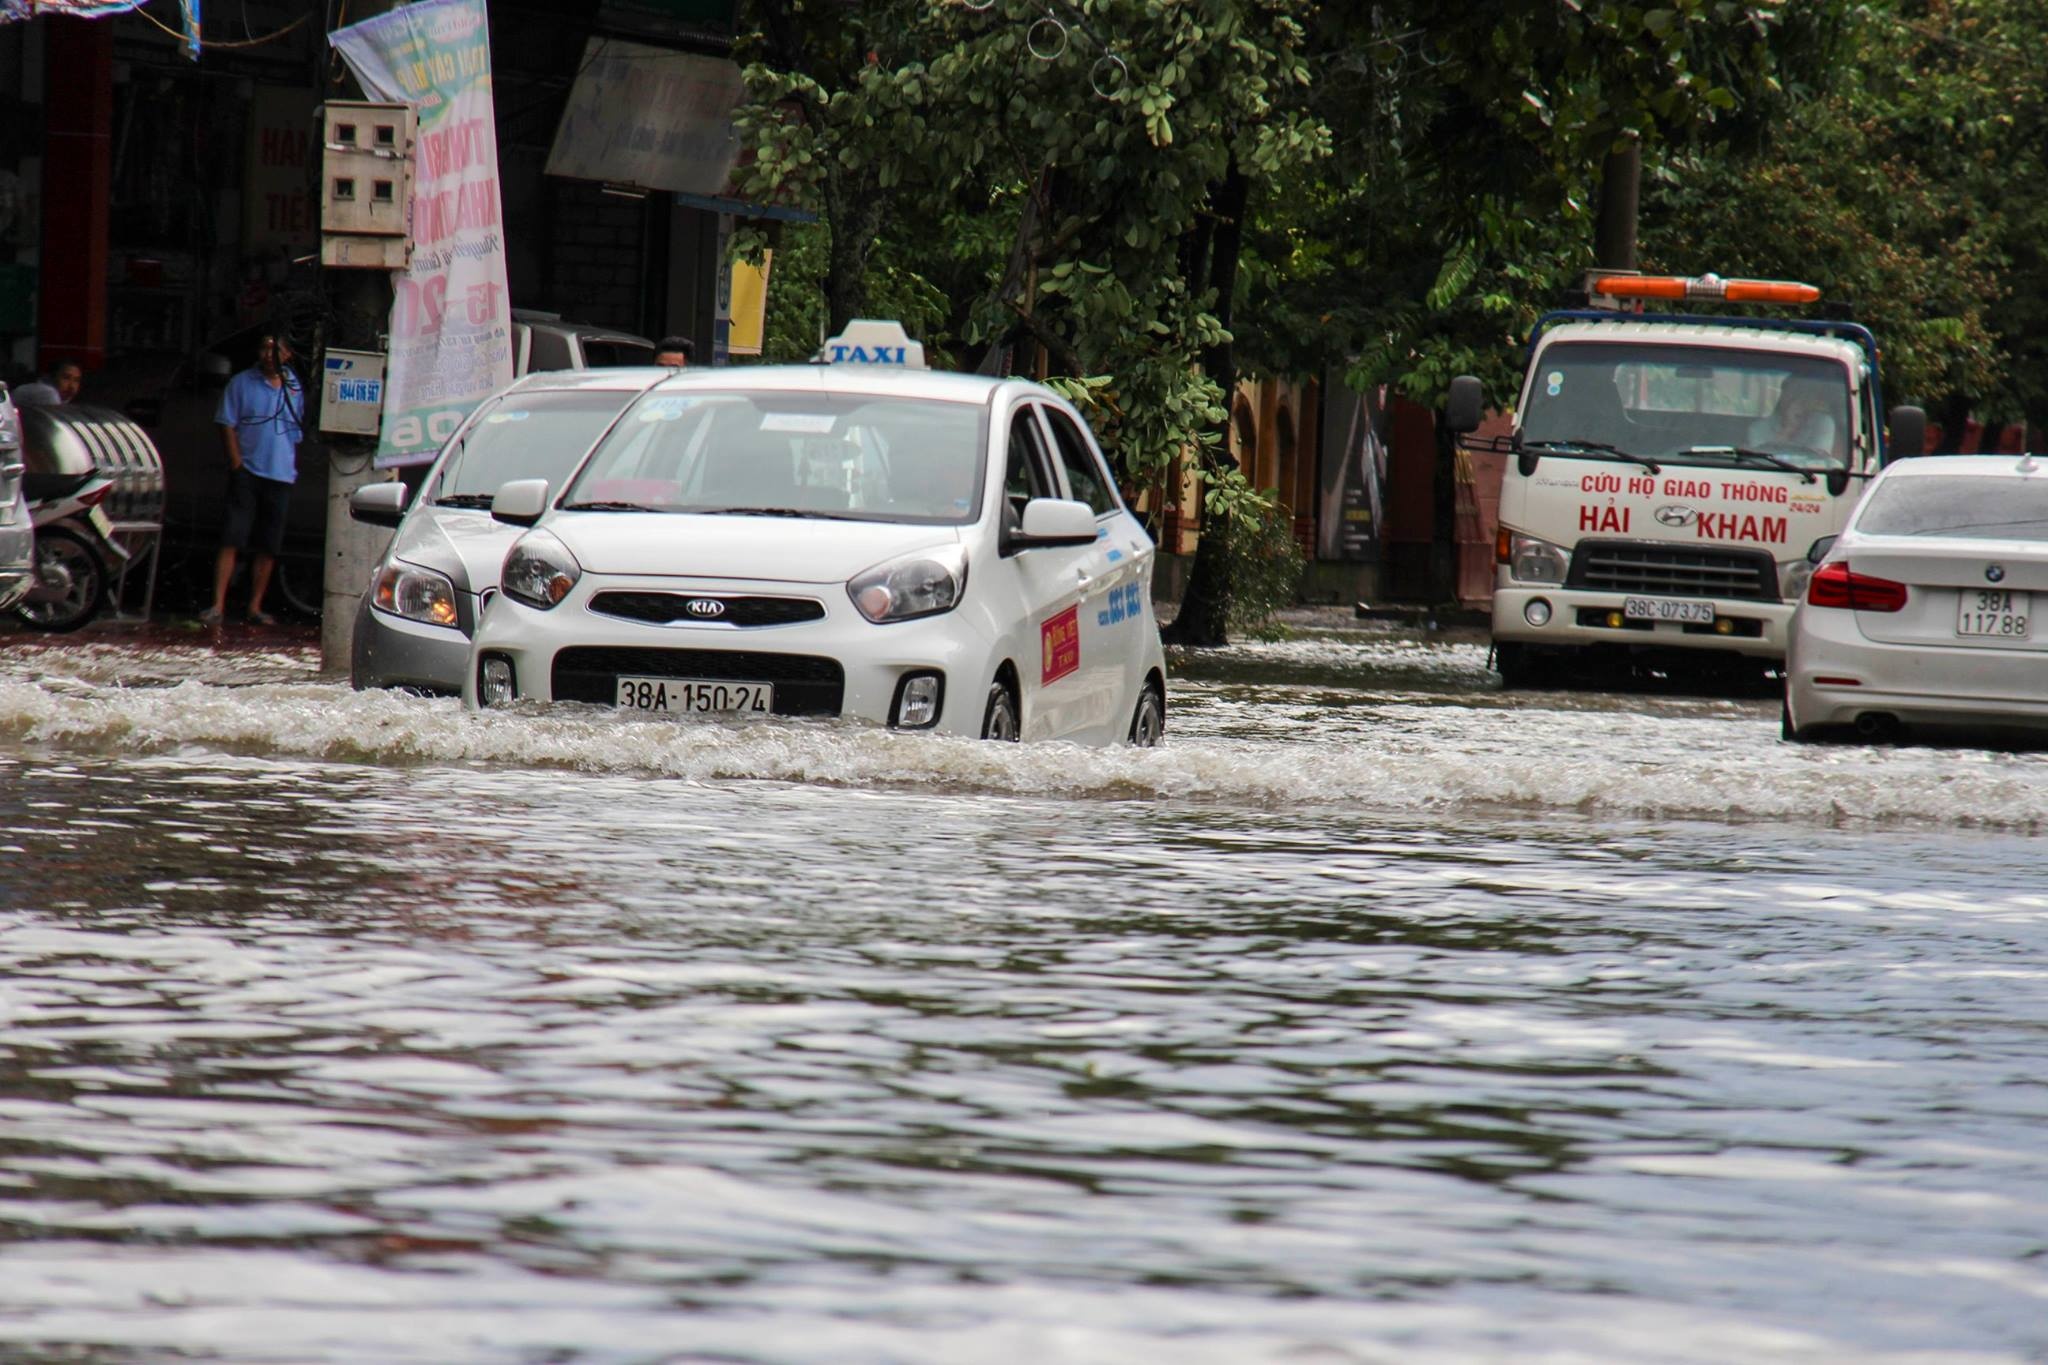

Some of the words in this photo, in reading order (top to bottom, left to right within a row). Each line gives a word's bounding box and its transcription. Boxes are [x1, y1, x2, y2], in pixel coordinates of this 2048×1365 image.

[830, 345, 906, 364] TAXI
[1581, 472, 1621, 493] CỨU
[1628, 475, 1655, 500] HỘ
[1663, 478, 1711, 499] GIAO
[1721, 480, 1788, 503] THÔNG
[1579, 497, 1631, 533] HẢI
[1697, 511, 1788, 544] KHAM
[691, 601, 718, 614] KIA
[1976, 591, 2012, 612] 38A
